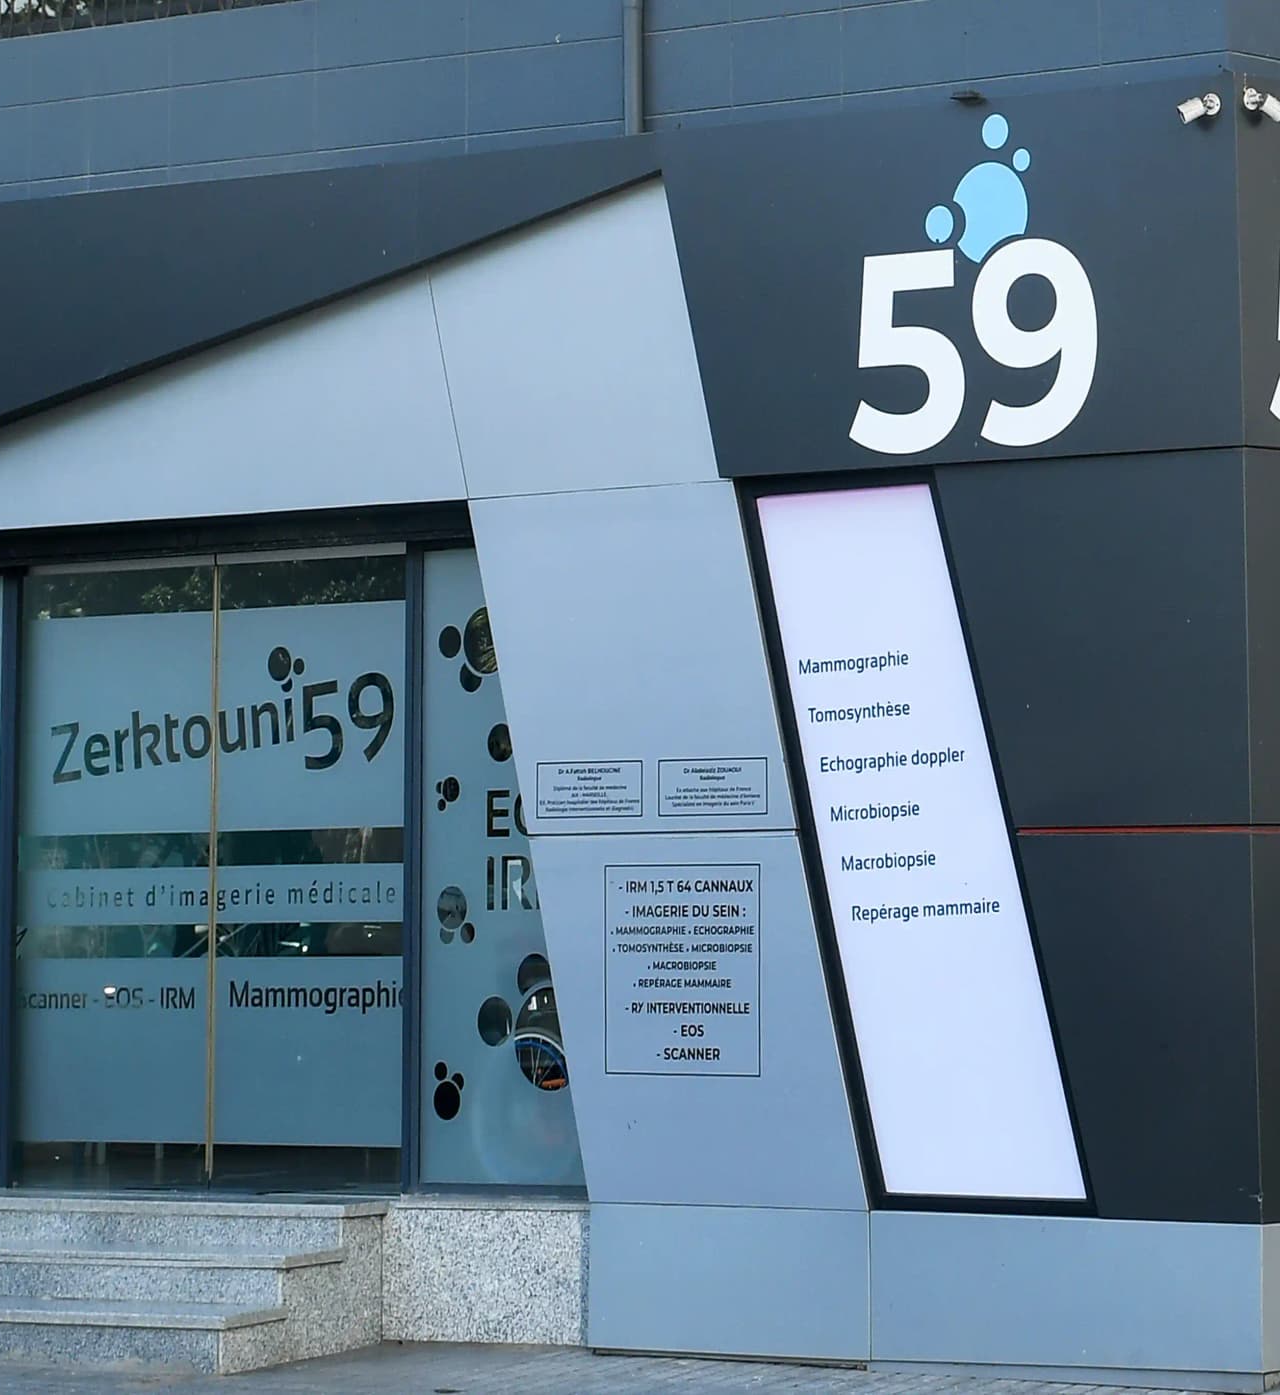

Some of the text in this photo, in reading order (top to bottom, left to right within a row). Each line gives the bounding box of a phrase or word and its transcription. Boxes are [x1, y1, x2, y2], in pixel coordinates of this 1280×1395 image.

[848, 238, 1098, 455] 59
[798, 650, 909, 674] Mammographie
[808, 701, 910, 723] Tomosynthèse
[820, 746, 965, 774] Echographie doppler
[830, 800, 920, 822] Microbiopsie
[840, 850, 936, 872] Macrobiopsie
[47, 886, 134, 909] Cabinet
[287, 881, 397, 904] médicale
[626, 881, 647, 892] IRM
[651, 880, 664, 895] 1,5
[667, 880, 675, 892] T
[677, 880, 691, 892] 64
[694, 880, 753, 892] CANNAUX
[632, 905, 689, 917] IMAGERIE
[692, 905, 709, 917] DU
[712, 905, 740, 917] SEIN
[851, 897, 1001, 924] Repérage mammaire
[616, 925, 755, 935] MAMMOGRAPHIE ECHOGRAPHIE
[617, 942, 753, 953] TOMOSYNTHÈSE MICROBIOPSIE
[652, 961, 717, 970] MACROBIOPSIE
[638, 977, 732, 988] REPÉRAGE MAMMAIRE
[160, 986, 196, 1009] IRM
[646, 1003, 750, 1014] INTERVENTIONNELLE
[680, 1025, 705, 1037] EOS
[663, 1048, 721, 1060] SCANNER
